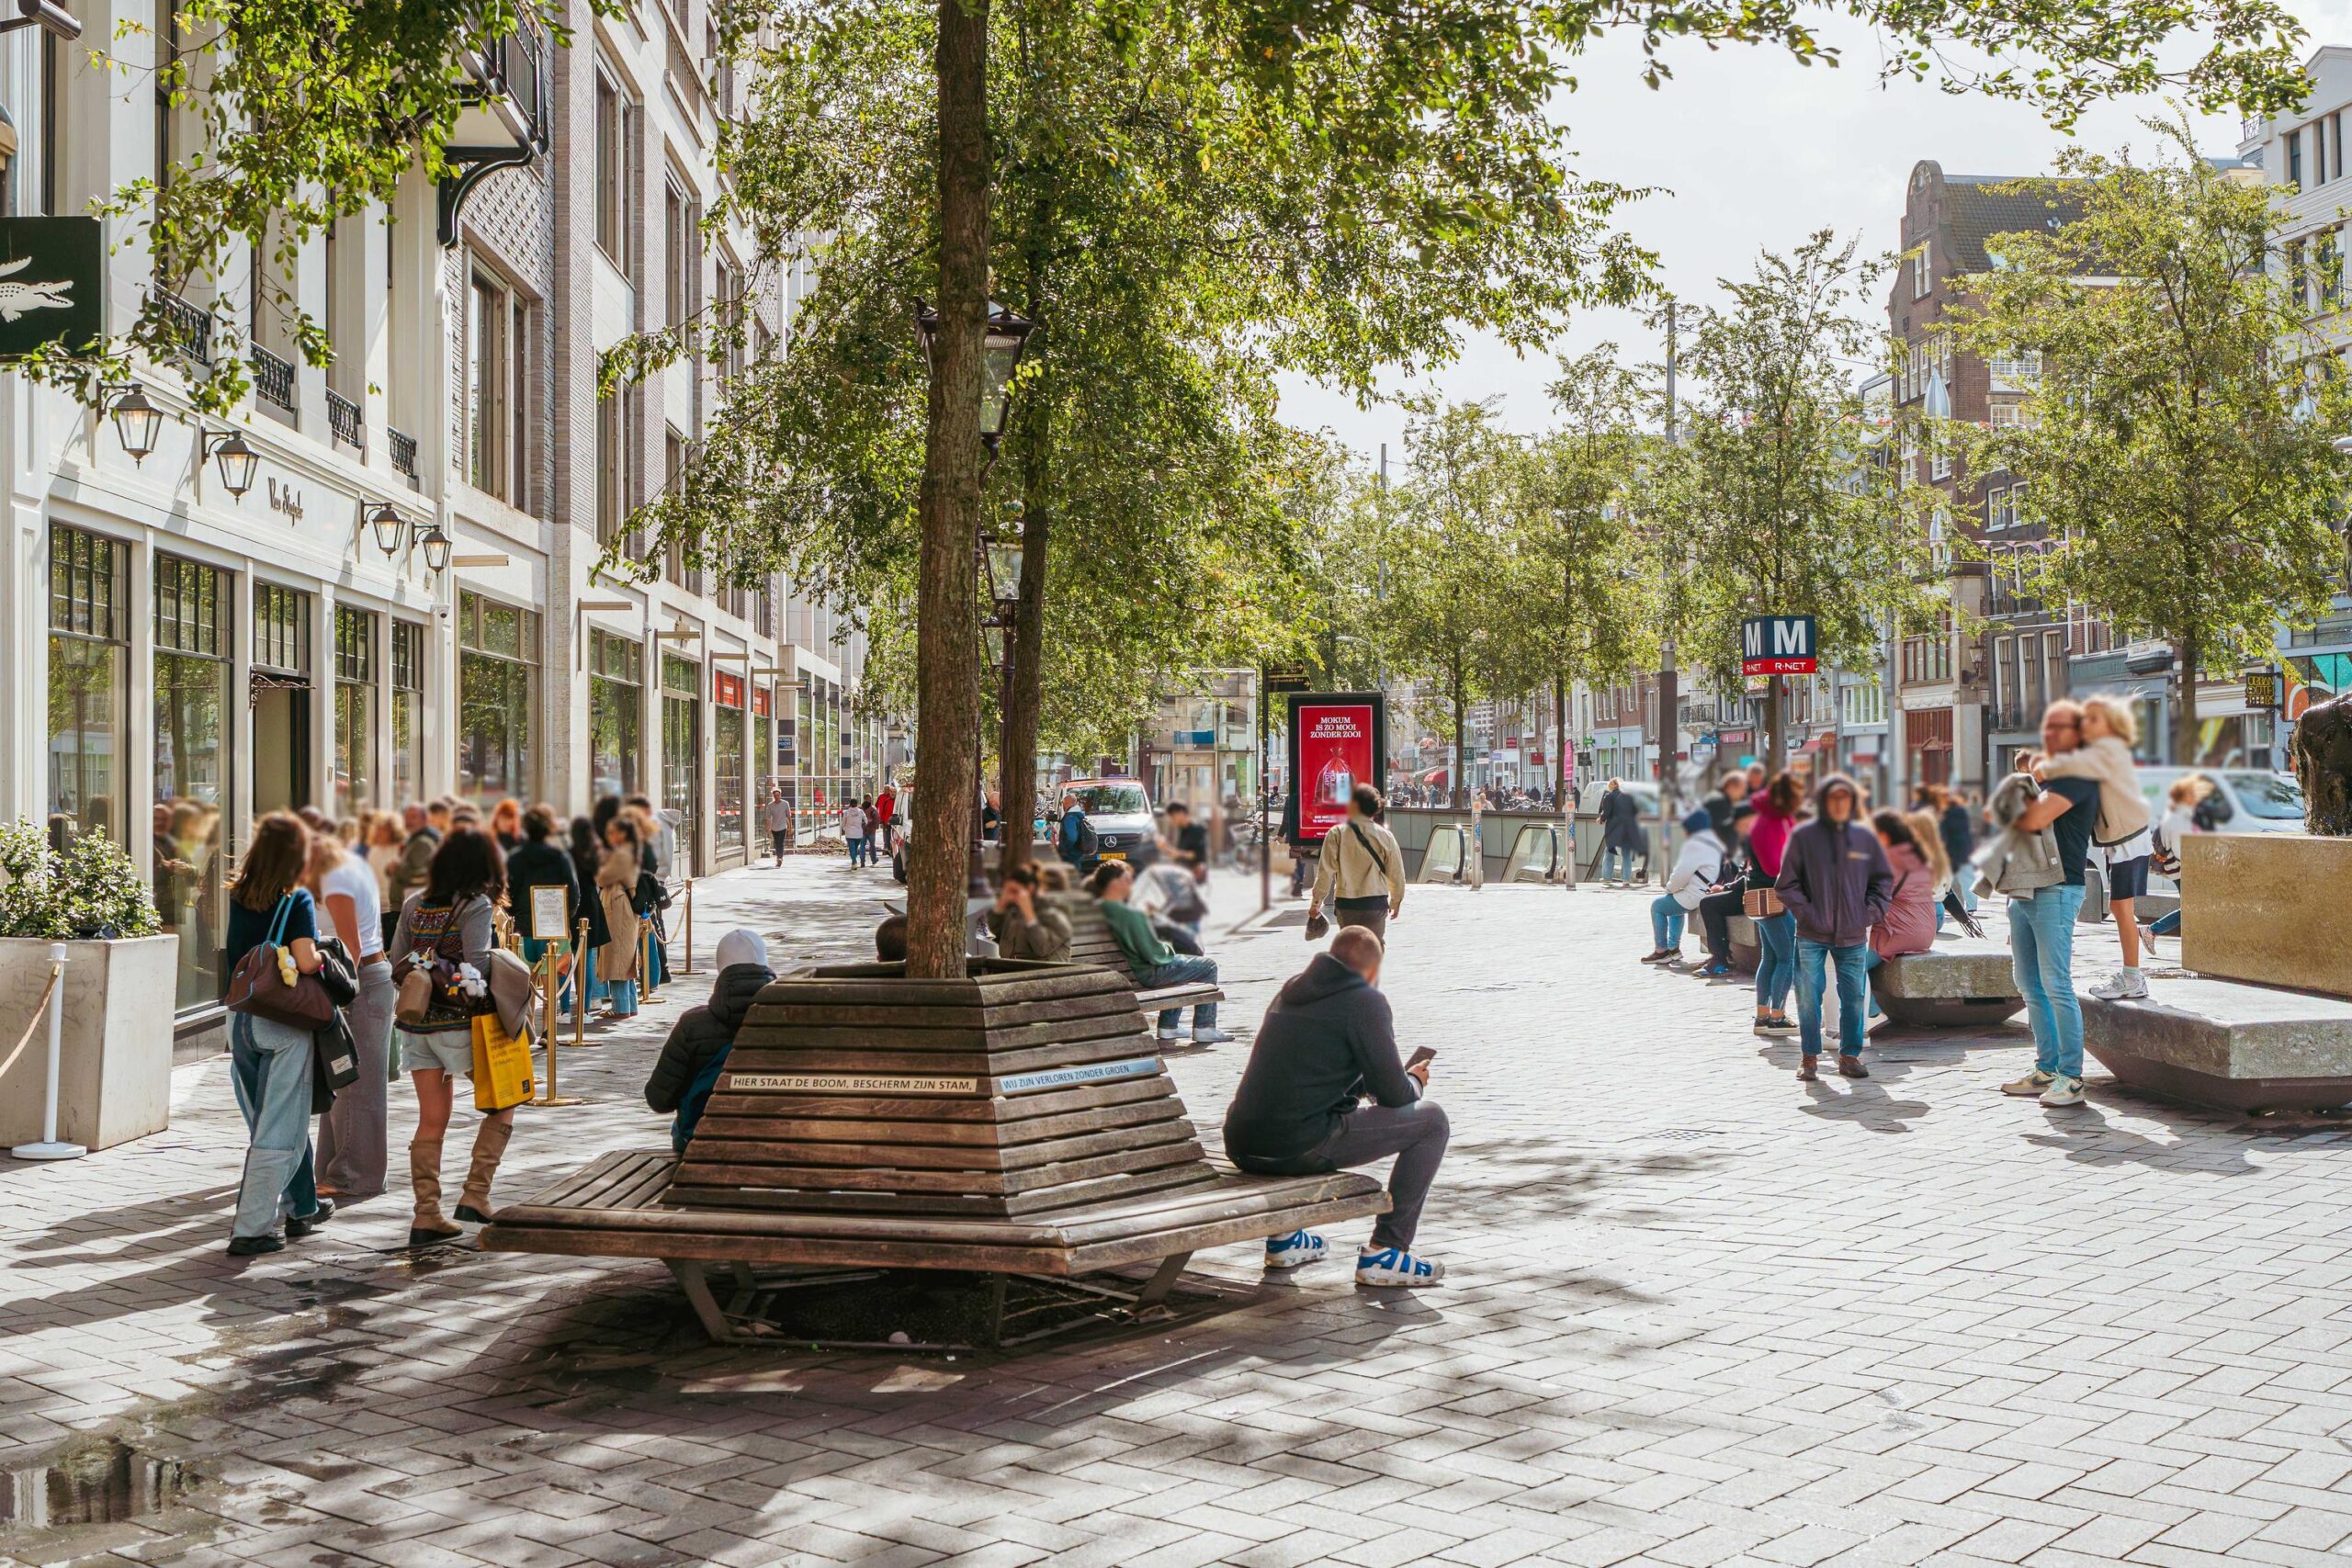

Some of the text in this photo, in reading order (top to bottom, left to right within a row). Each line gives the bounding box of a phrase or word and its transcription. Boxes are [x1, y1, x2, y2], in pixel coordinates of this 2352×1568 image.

[267, 476, 281, 512] Van
[1745, 621, 1762, 658] M
[1773, 620, 1807, 655] M
[733, 1077, 974, 1092] HIER STAAT DE BOOM, BESCHERM ZIJN STAM,
[1002, 1065, 1130, 1089] WIJ ZIJN VERLOREN ZONDER GROEN
